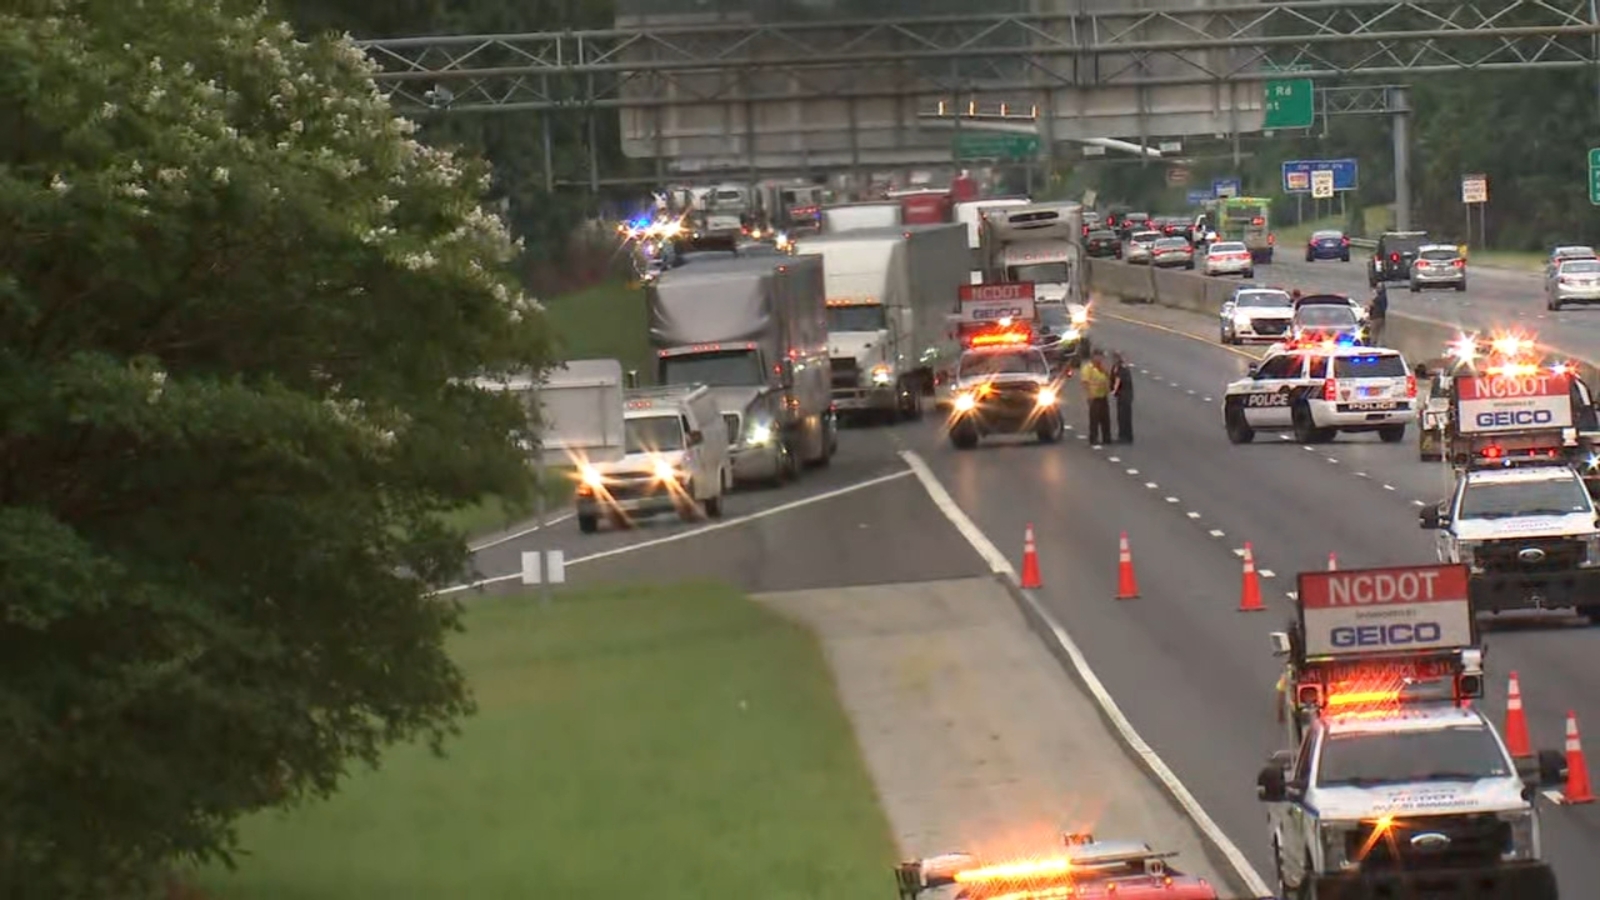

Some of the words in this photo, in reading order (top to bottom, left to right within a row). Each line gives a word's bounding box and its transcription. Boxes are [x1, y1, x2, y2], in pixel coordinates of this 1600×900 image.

[1275, 85, 1292, 96] Rd
[1315, 186, 1330, 195] 65
[971, 285, 1021, 299] NCDOT
[1475, 375, 1550, 397] NCDOT
[1249, 393, 1289, 407] POLICE
[1349, 402, 1397, 411] POLICE
[1476, 409, 1552, 427] GEICO
[1328, 571, 1439, 605] NCDOT
[1331, 622, 1441, 647] GEICO
